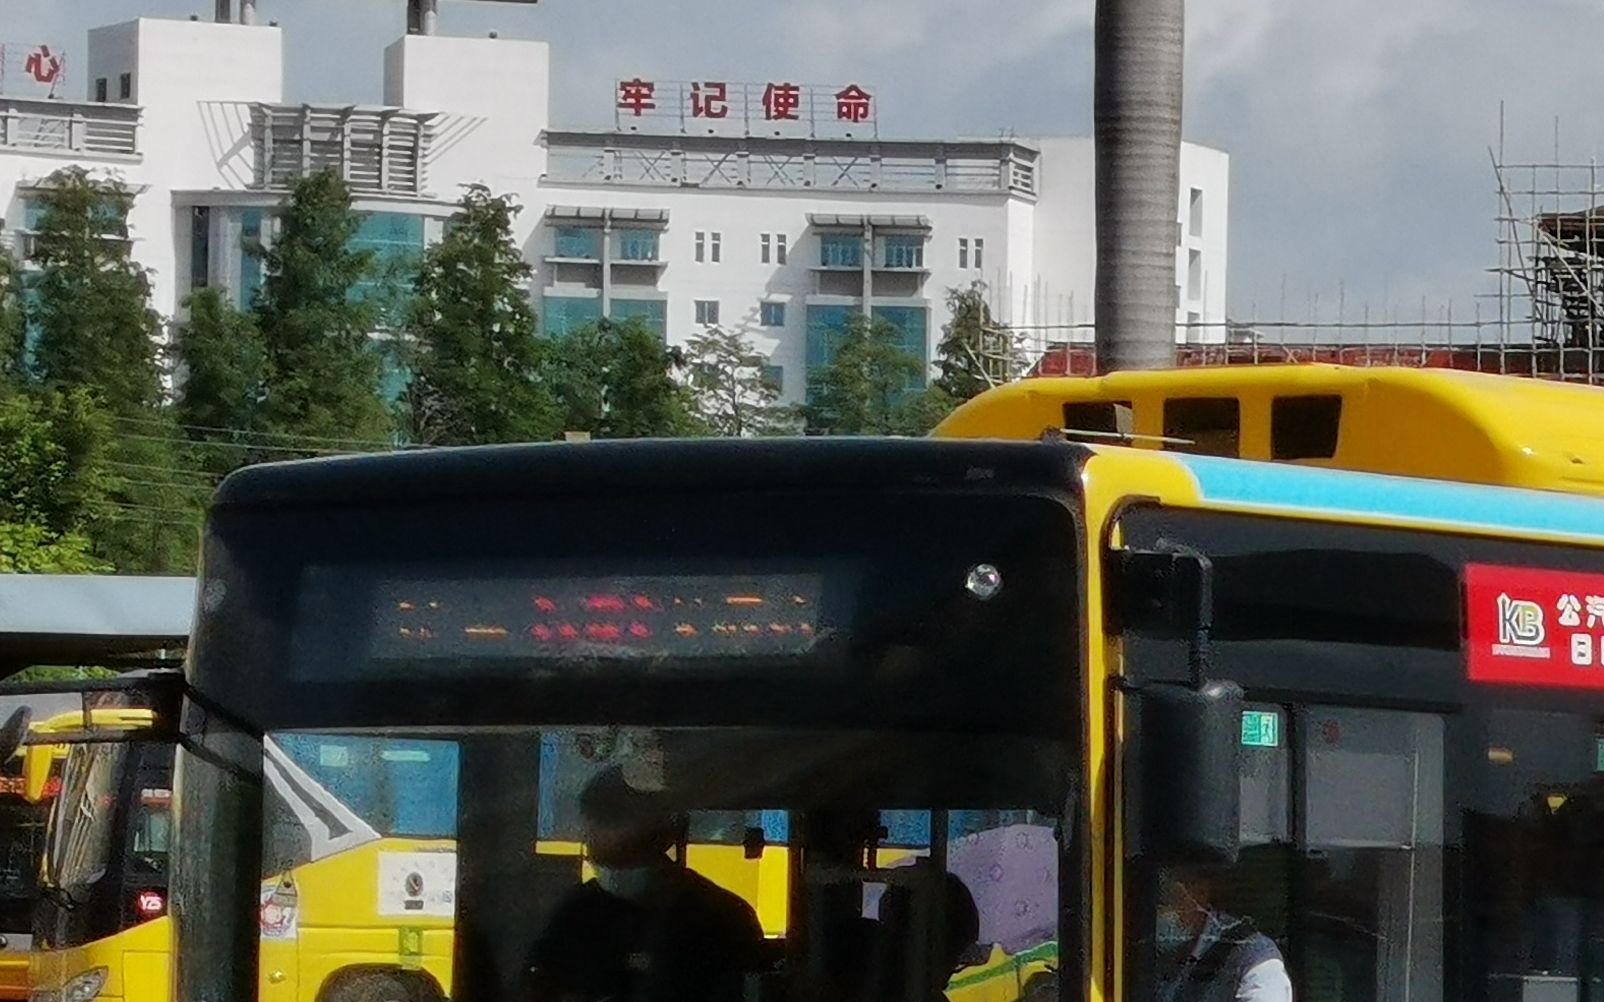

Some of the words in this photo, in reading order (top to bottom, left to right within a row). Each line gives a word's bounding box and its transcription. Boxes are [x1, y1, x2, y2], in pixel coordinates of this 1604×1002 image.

[25, 44, 60, 83] 心
[616, 78, 872, 123] 牢记使命
